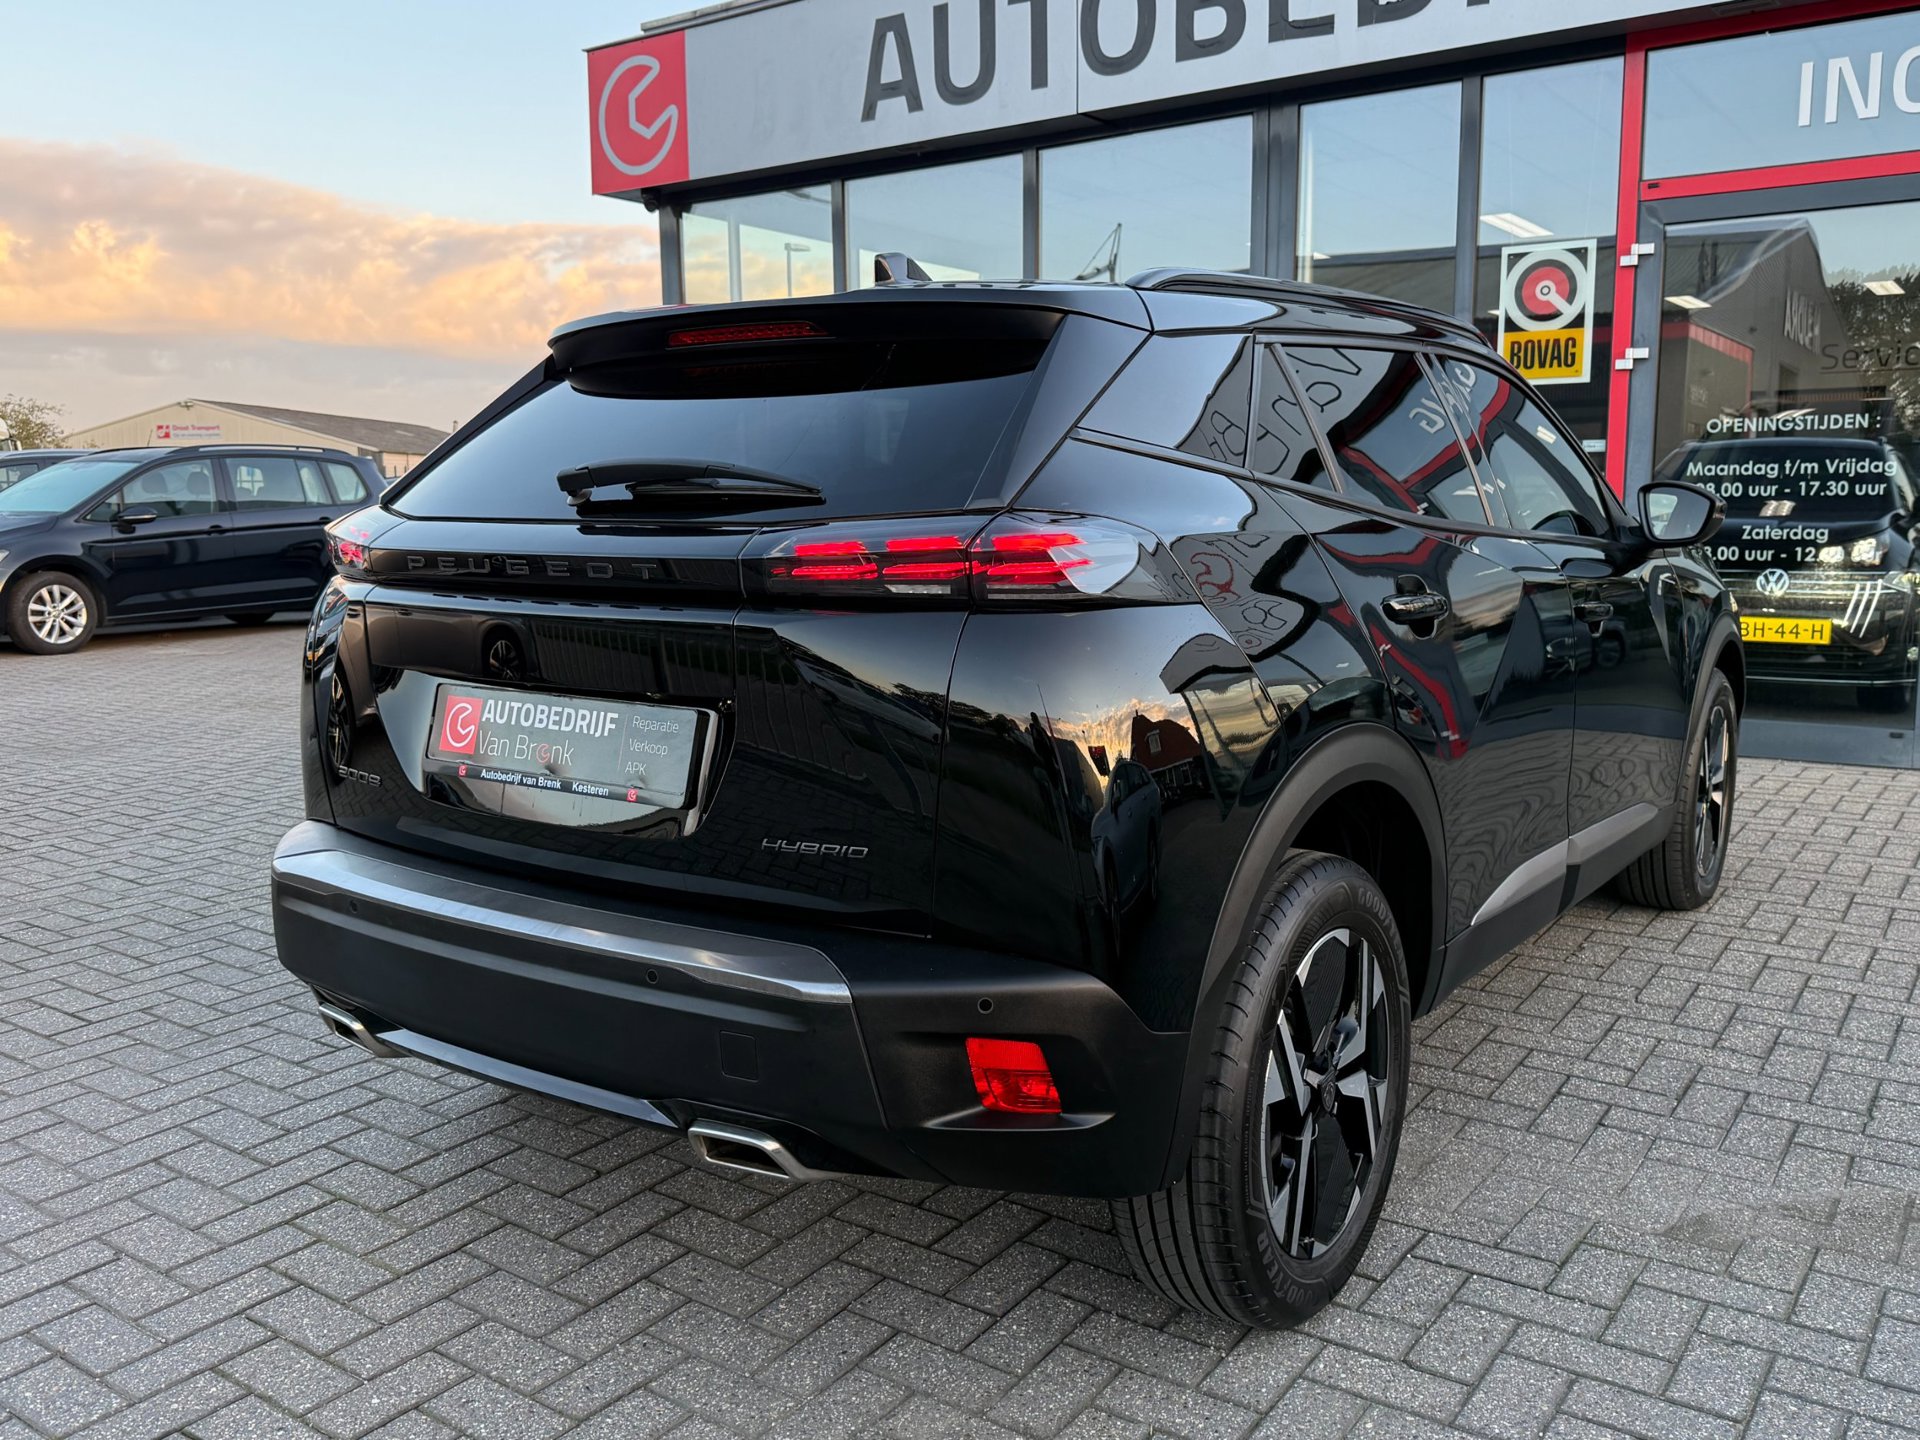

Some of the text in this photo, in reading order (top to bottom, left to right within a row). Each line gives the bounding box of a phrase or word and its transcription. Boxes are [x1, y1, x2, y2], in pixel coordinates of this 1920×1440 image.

[1510, 337, 1577, 370] BOVAG
[1706, 414, 1869, 433] OPENINGSTIJDEN
[1686, 458, 1898, 478] Maandag t/m Vrijdag
[1696, 482, 1743, 497] 8.00
[1748, 484, 1778, 497] uur
[1799, 481, 1849, 496] 17.30
[1855, 482, 1887, 496] uur
[1742, 525, 1829, 543] Zaterdag
[1744, 548, 1775, 562] uur
[407, 556, 657, 580] PEUGEOT
[482, 699, 619, 737] AUTOBEDRIJF
[632, 715, 679, 733] Reparatie
[479, 730, 510, 758] Van
[629, 738, 668, 757] Verkoop
[625, 761, 647, 775] APK
[480, 769, 609, 797] Autobedrijf van Brenk Kesteren
[761, 838, 869, 858] HYBRID
